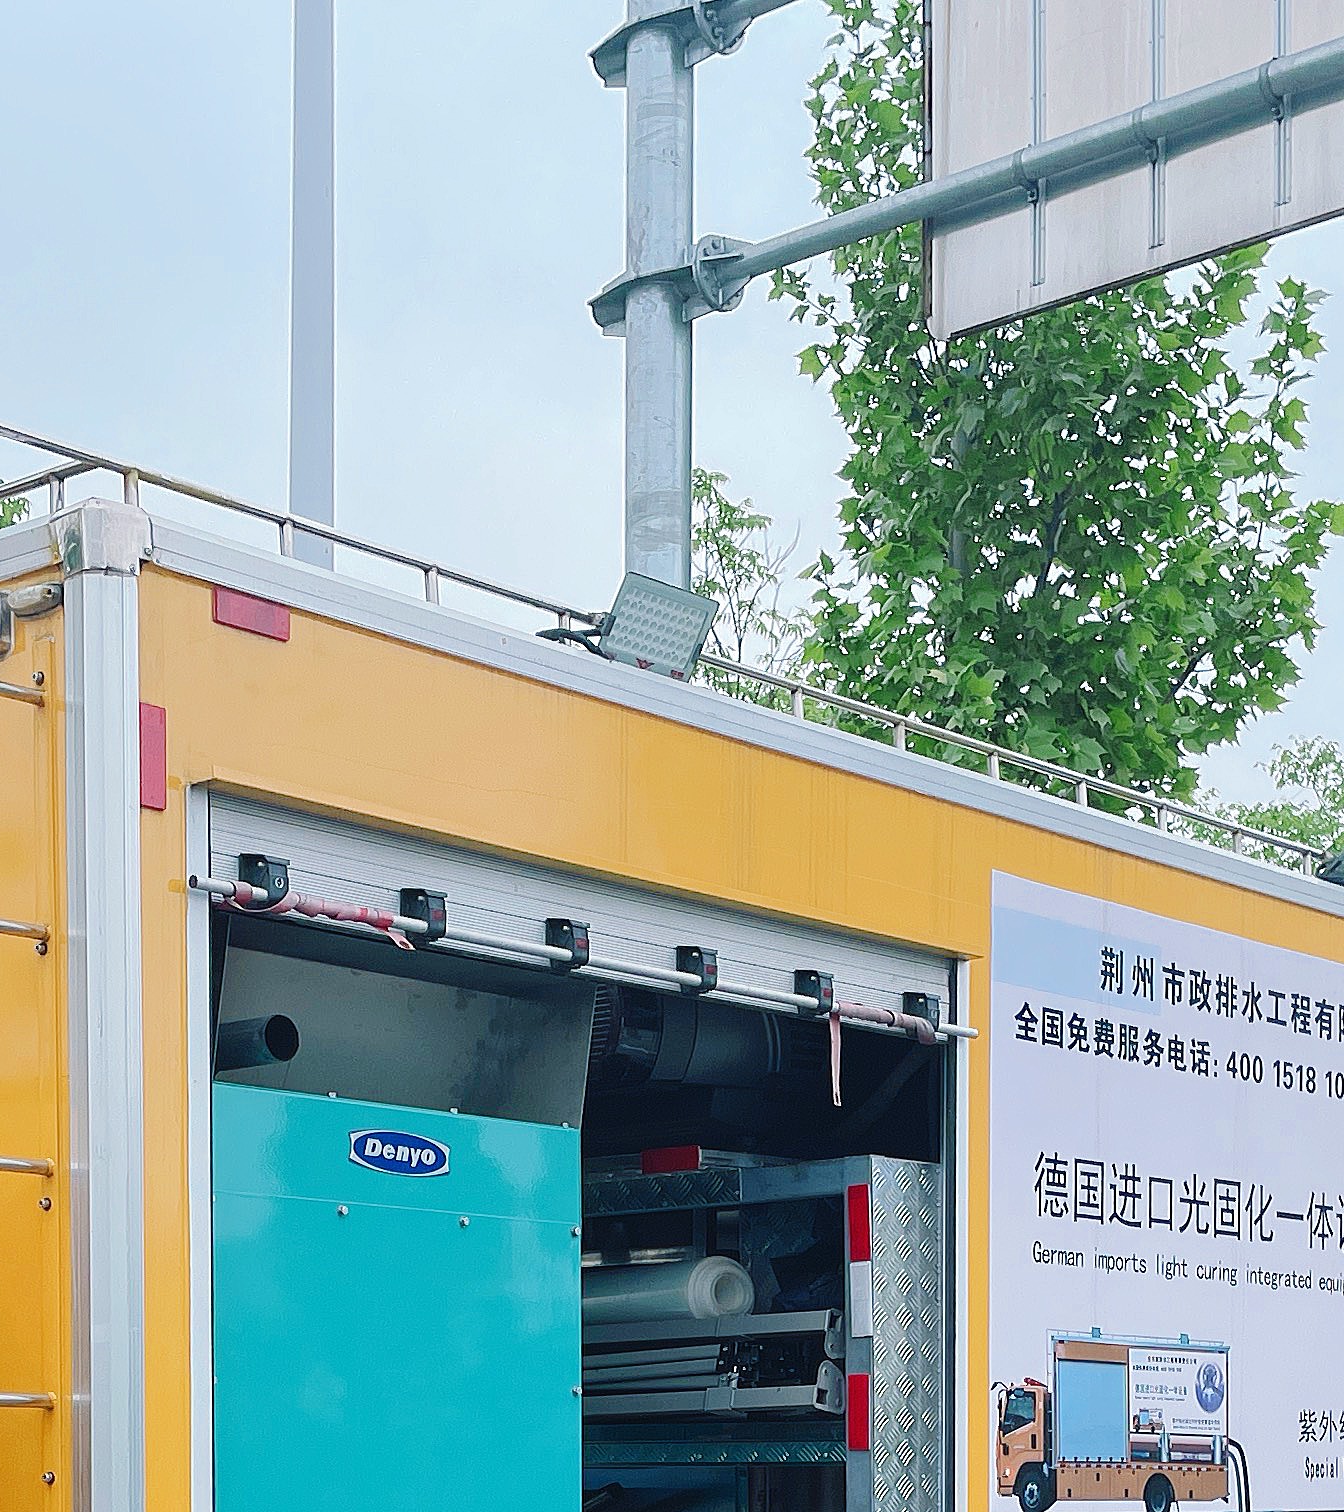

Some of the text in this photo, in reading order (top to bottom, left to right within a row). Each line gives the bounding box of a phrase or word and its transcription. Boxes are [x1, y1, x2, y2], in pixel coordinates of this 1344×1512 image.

[1226, 1051, 1264, 1084] 400
[1272, 1059, 1317, 1095] 1518
[364, 1137, 437, 1168] Denyo
[1032, 1241, 1085, 1270] German
[1094, 1250, 1148, 1275] imports
[1156, 1251, 1189, 1281] light
[1196, 1263, 1238, 1287] curing
[1246, 1264, 1312, 1291] integrated
[1305, 1456, 1339, 1482] Special
